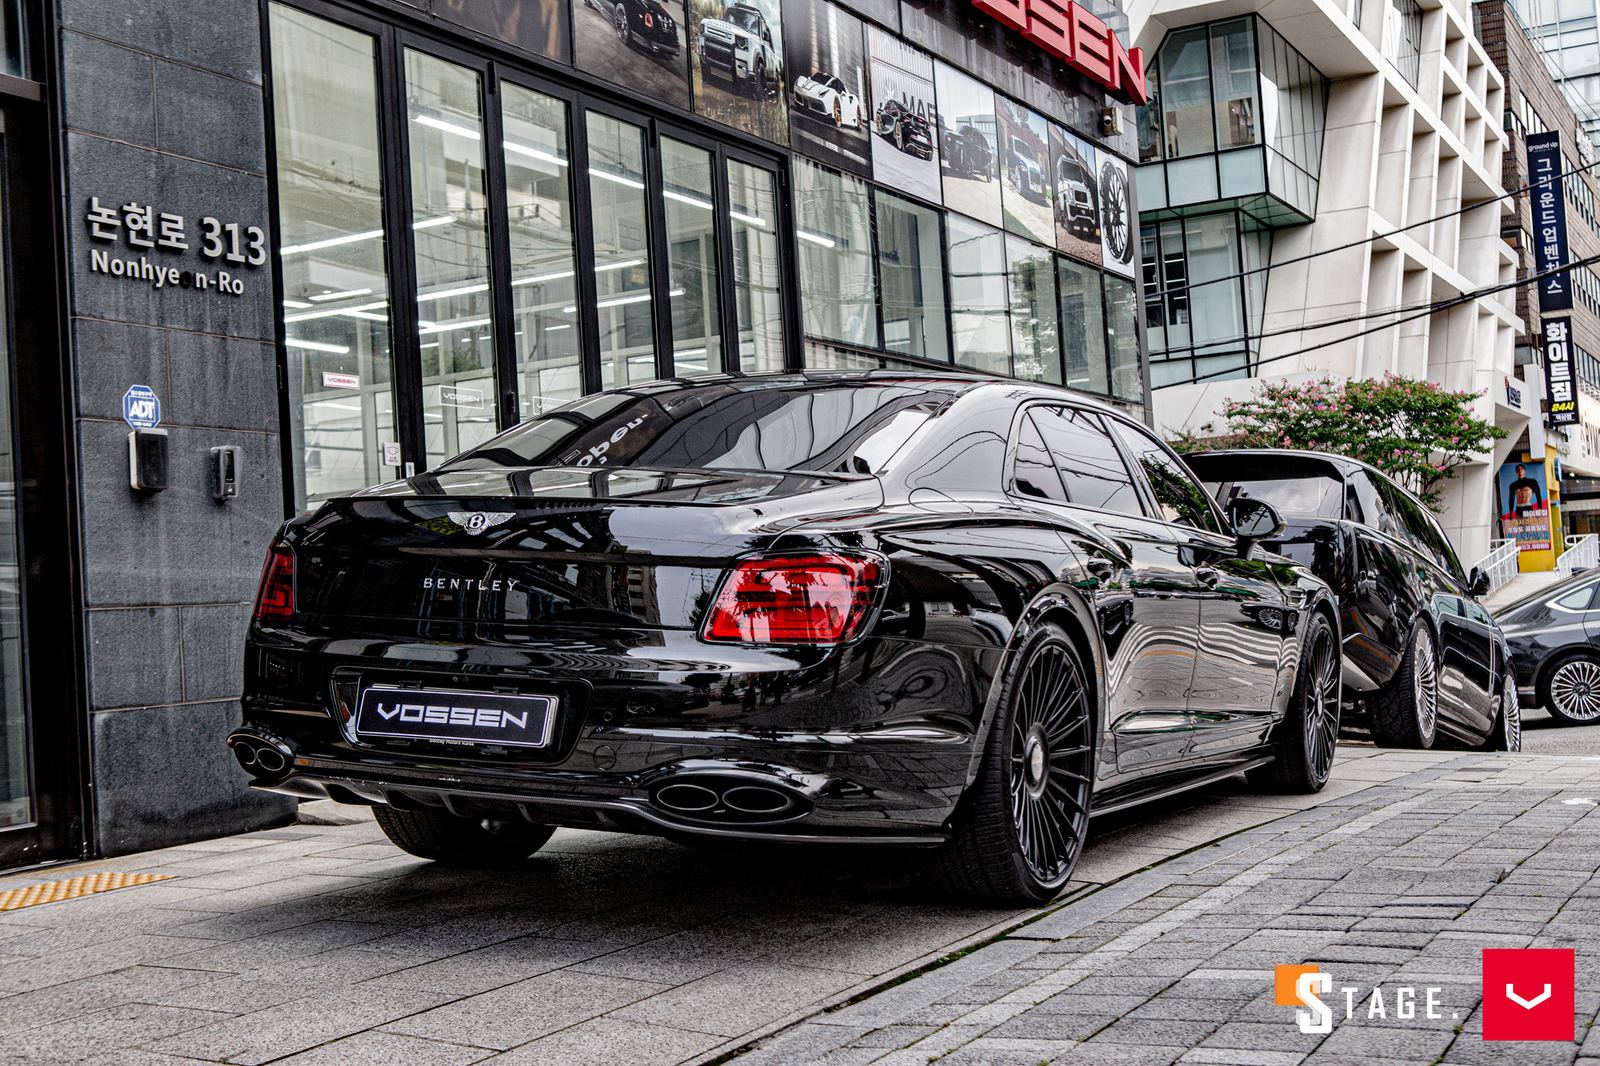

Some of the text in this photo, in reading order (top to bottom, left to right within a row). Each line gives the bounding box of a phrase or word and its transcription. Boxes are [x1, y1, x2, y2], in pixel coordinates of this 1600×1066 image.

[87, 196, 267, 266] 논현로 313
[91, 249, 245, 296] Nonhyen-Ro
[1545, 321, 1573, 403] 화이트짐
[328, 377, 356, 385] VOSSEN
[129, 400, 154, 419] ADT
[423, 577, 518, 592] BENTLEY
[377, 702, 528, 729] VOSSEN
